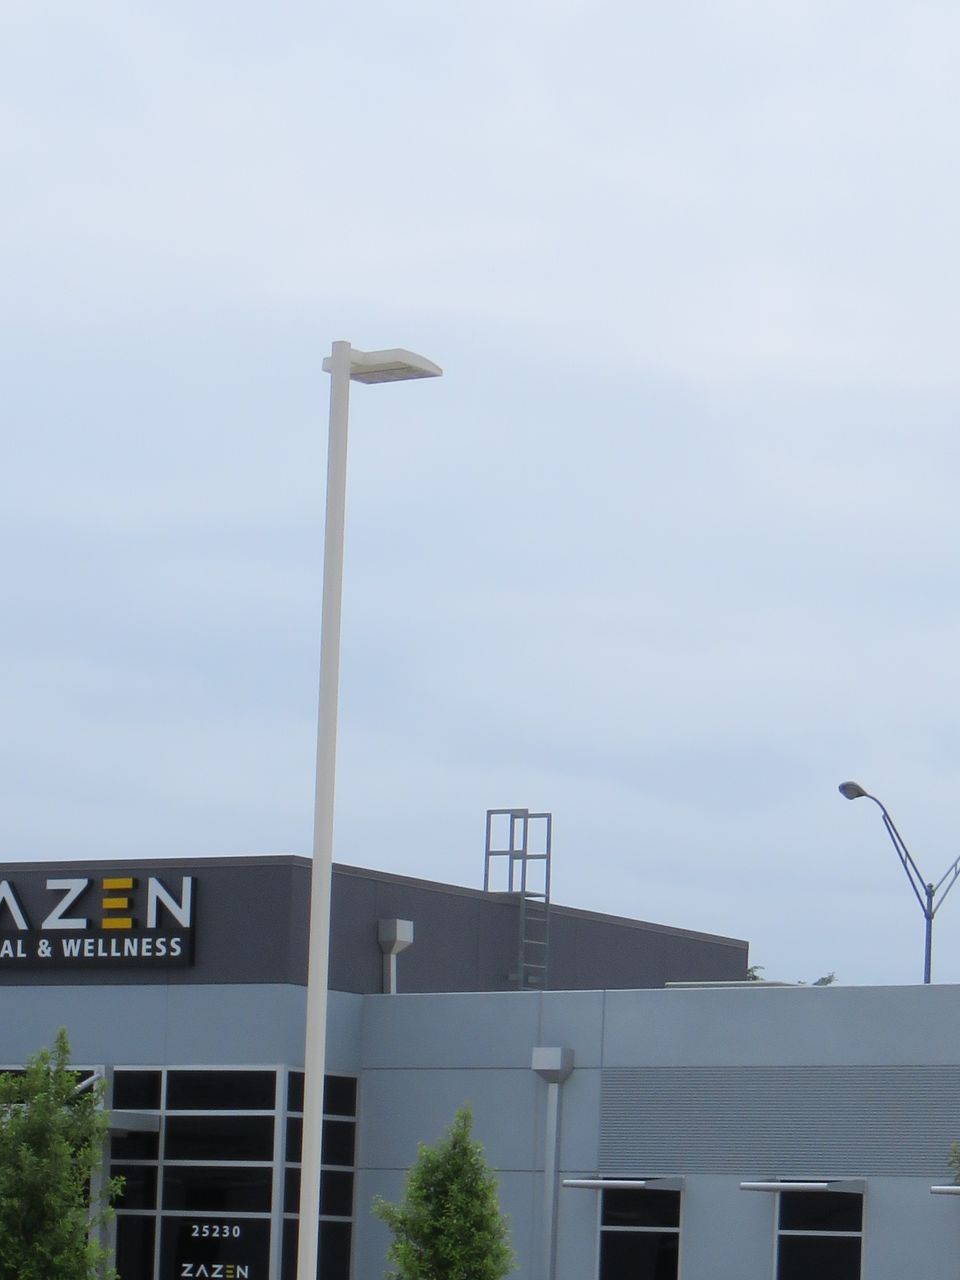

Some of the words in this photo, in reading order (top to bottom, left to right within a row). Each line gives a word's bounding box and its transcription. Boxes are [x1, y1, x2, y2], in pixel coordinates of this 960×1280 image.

[38, 939, 52, 958] &
[62, 937, 182, 957] WELLNESS
[191, 1225, 241, 1237] 25230
[180, 1263, 249, 1279] ZAZEN
